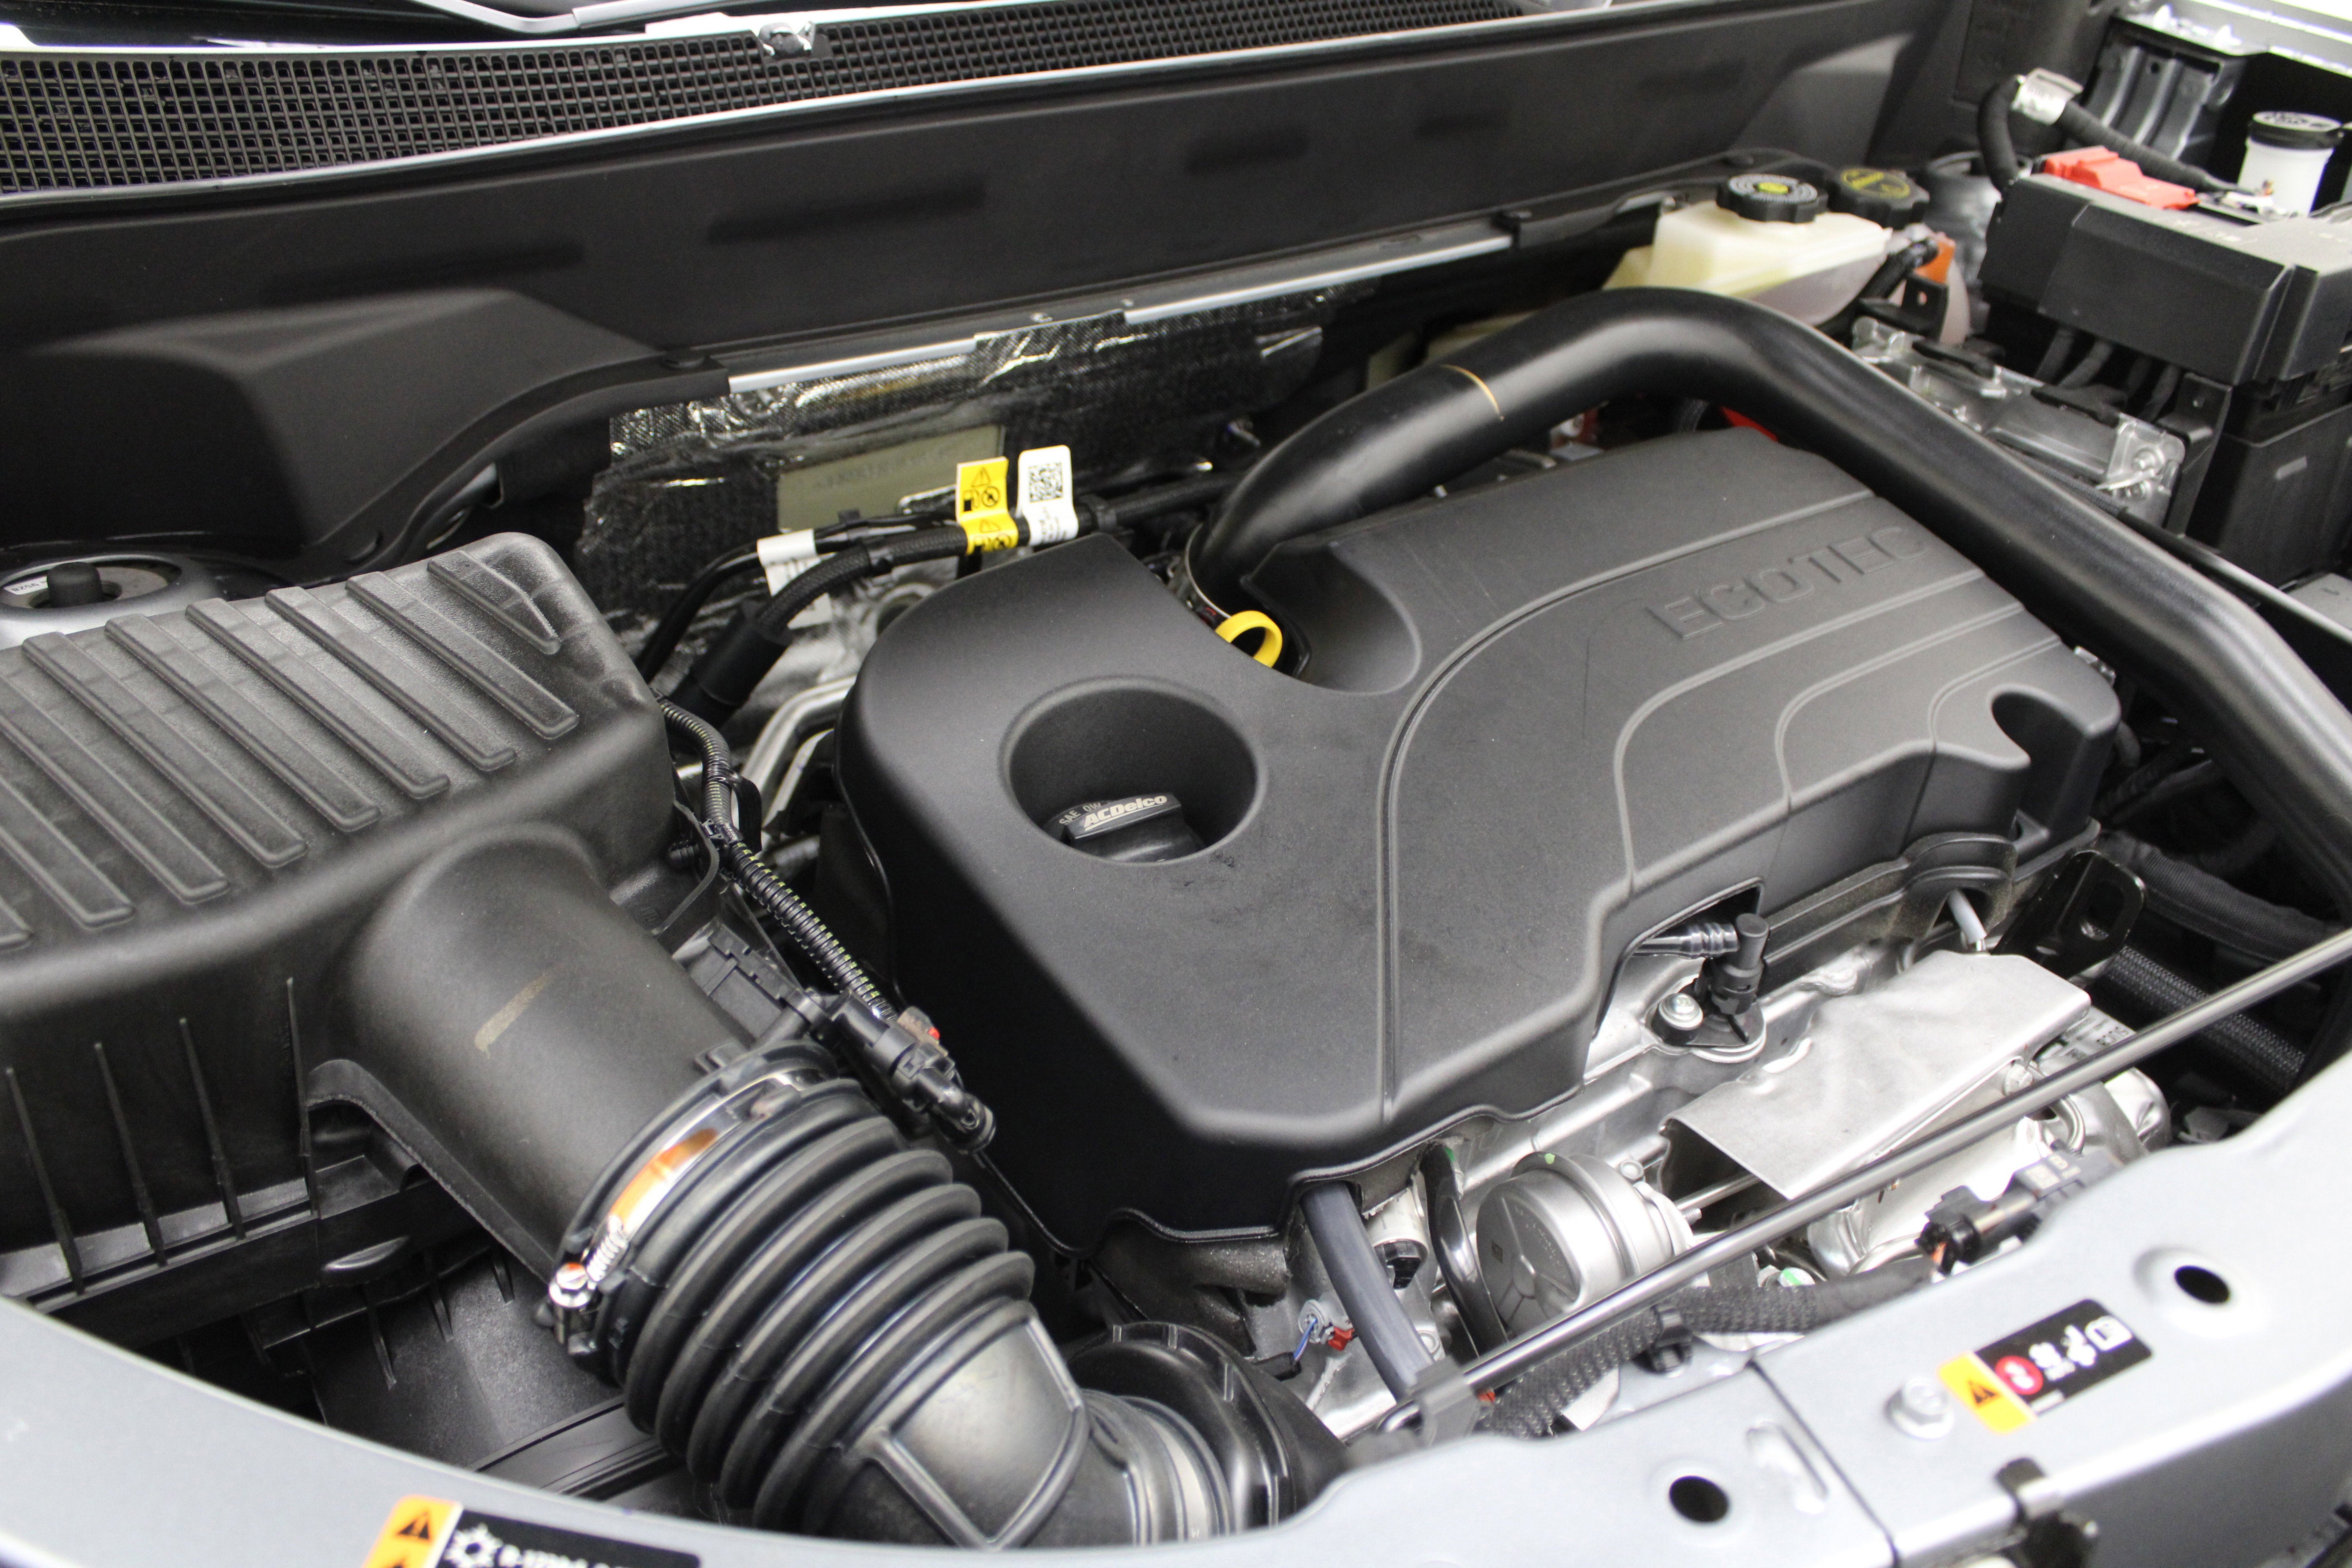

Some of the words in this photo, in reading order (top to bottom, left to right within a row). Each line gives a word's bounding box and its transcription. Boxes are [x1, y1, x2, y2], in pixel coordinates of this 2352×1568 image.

[1645, 527, 1930, 640] ECOTEC
[1059, 810, 1081, 825] SAE
[1084, 795, 1167, 828] ACDelco
